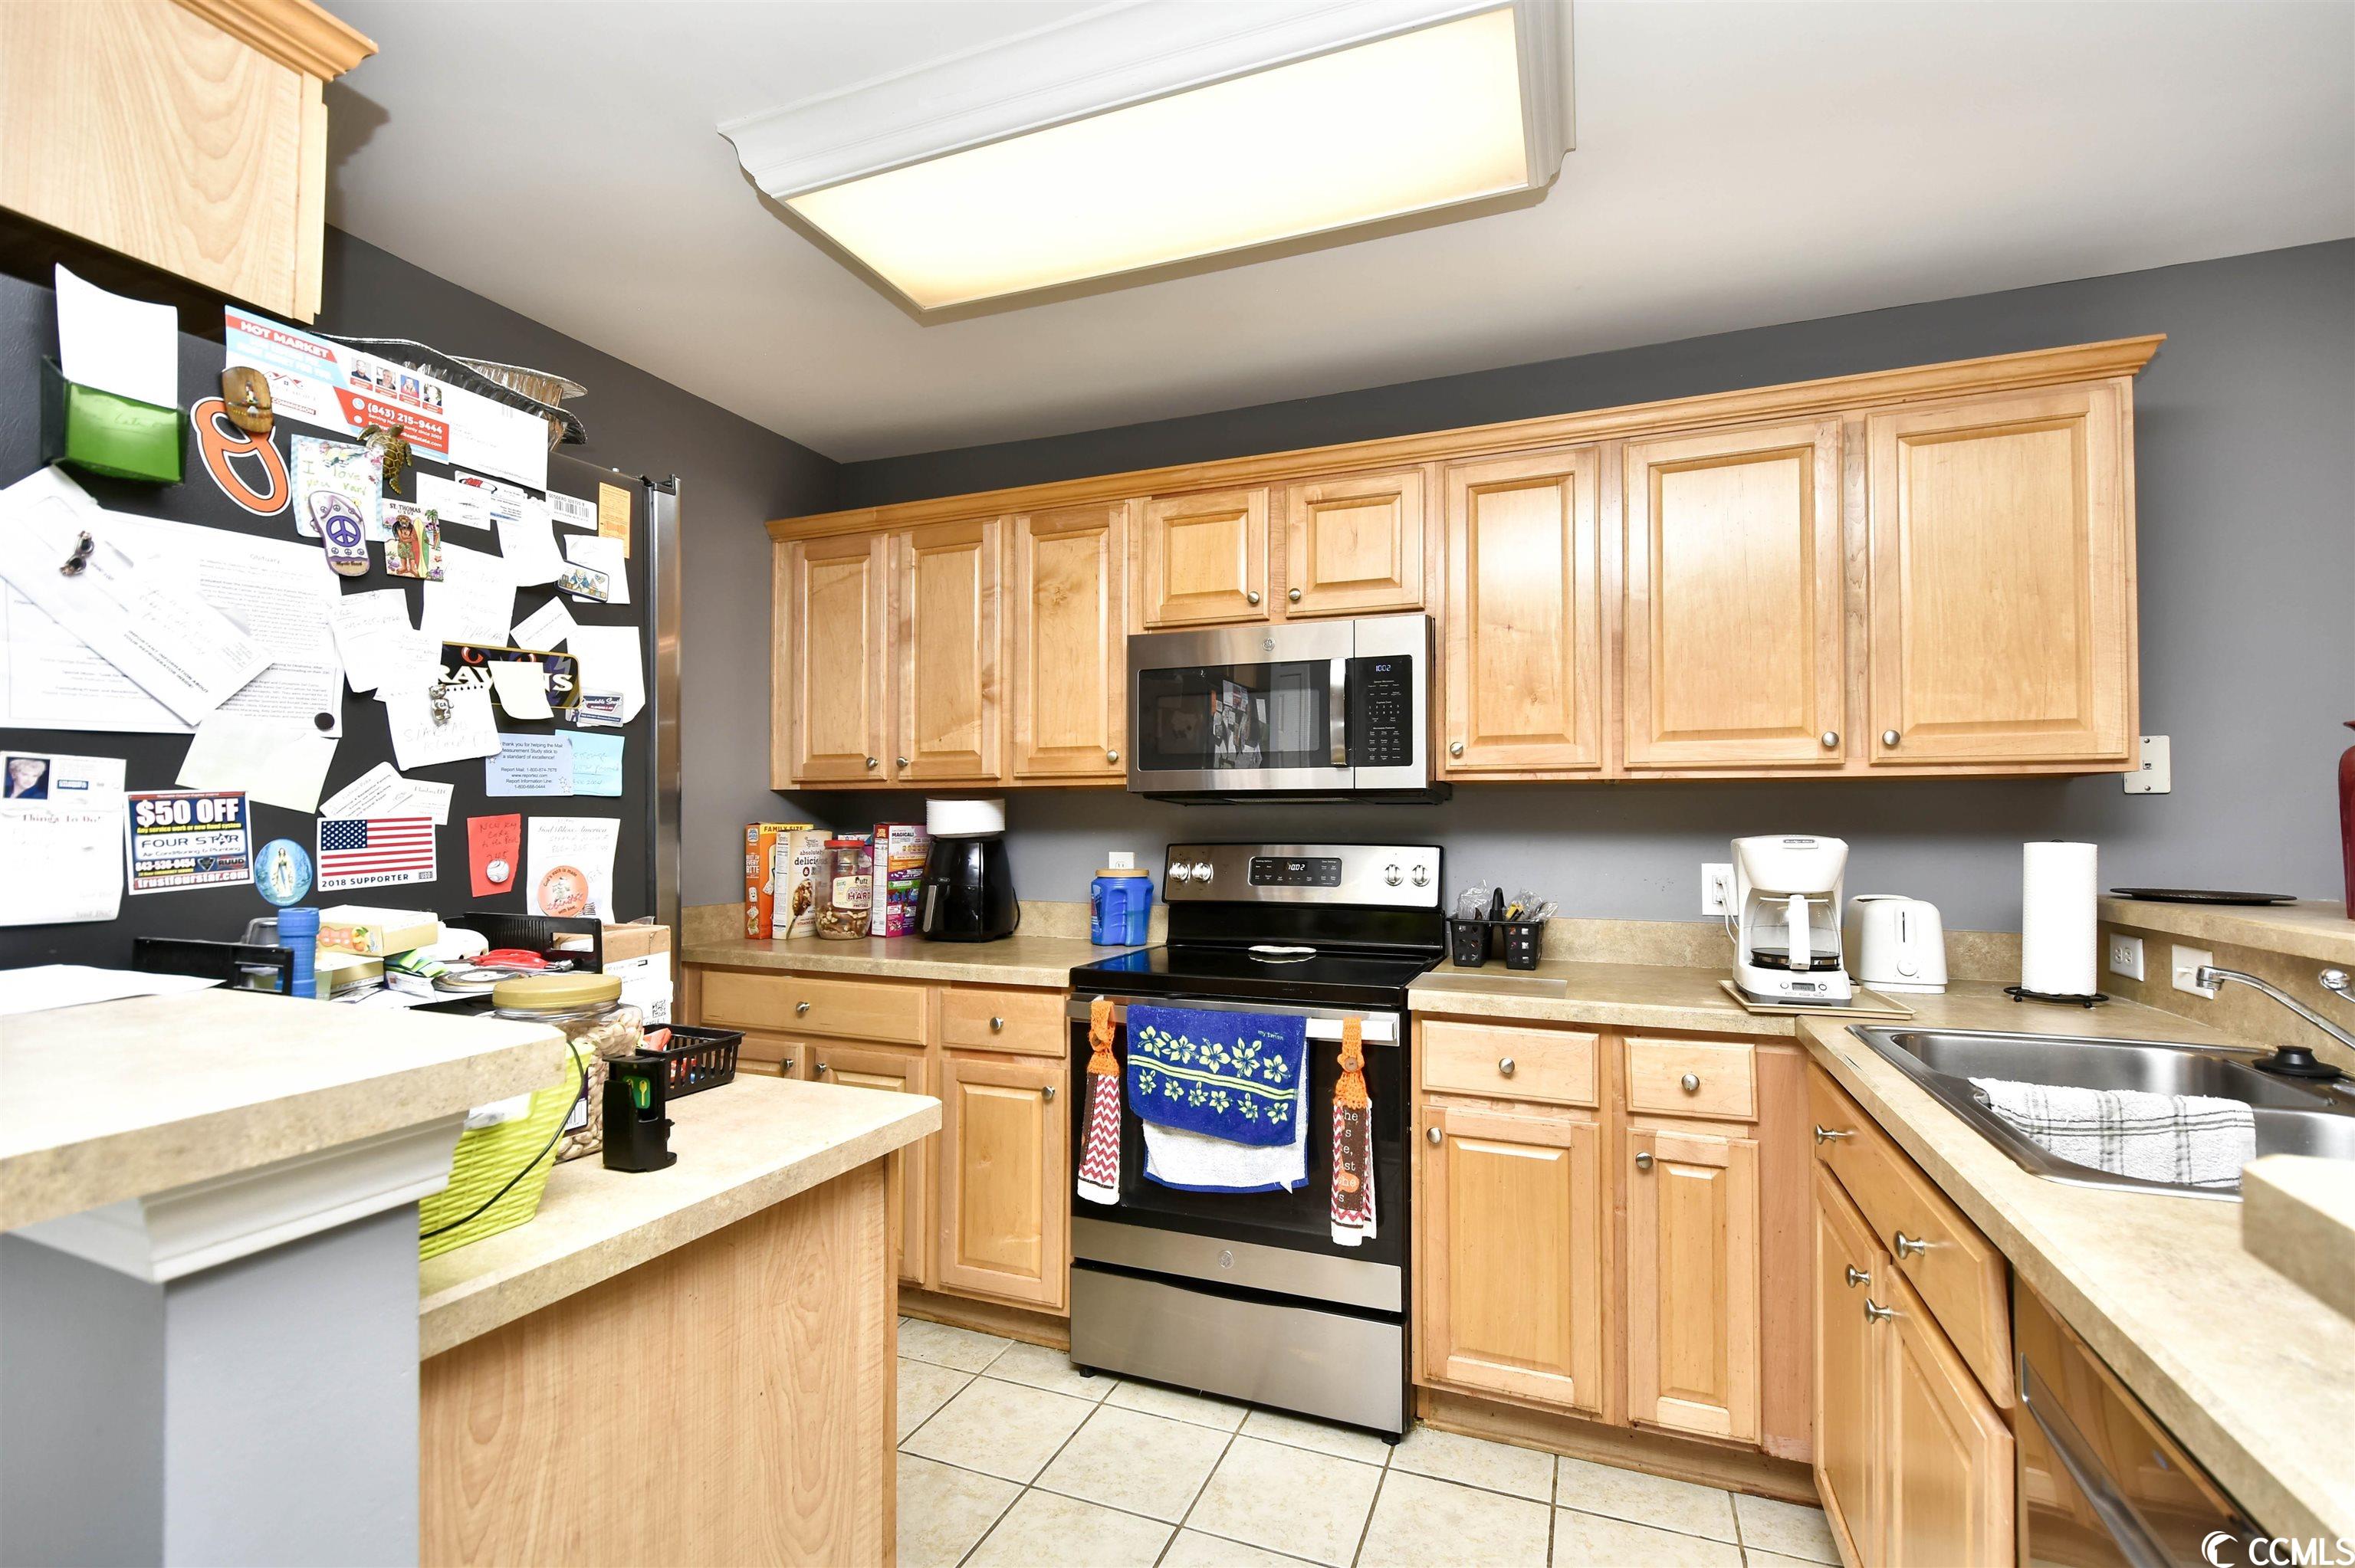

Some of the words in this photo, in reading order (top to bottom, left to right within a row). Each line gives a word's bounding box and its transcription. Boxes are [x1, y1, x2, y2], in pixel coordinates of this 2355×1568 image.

[241, 321, 271, 339] HOT
[273, 333, 330, 360] MARKET
[368, 402, 395, 421] (843)
[397, 413, 443, 435] 215-9444
[303, 461, 314, 475] I
[333, 463, 360, 481] love
[399, 504, 421, 513] THOMAS
[123, 632, 139, 646] YOUR
[127, 628, 159, 654] IMPORTANT
[158, 651, 193, 681] INFORMATION
[191, 678, 209, 694] ABOUT
[438, 664, 573, 694] RAVS
[23, 814, 60, 824] Things
[136, 799, 192, 828] $50
[195, 798, 239, 825] OFF
[149, 825, 172, 834] service
[222, 822, 242, 831] system
[580, 825, 608, 834] America
[141, 838, 189, 848] FOUR
[195, 832, 239, 845] STAR
[156, 848, 201, 857] Conditioning
[218, 858, 245, 868] RUUD
[136, 870, 249, 889] trustfourstar.com
[321, 878, 347, 888] 2018
[350, 873, 409, 886] SUPPORTER
[848, 891, 871, 900] HARD
